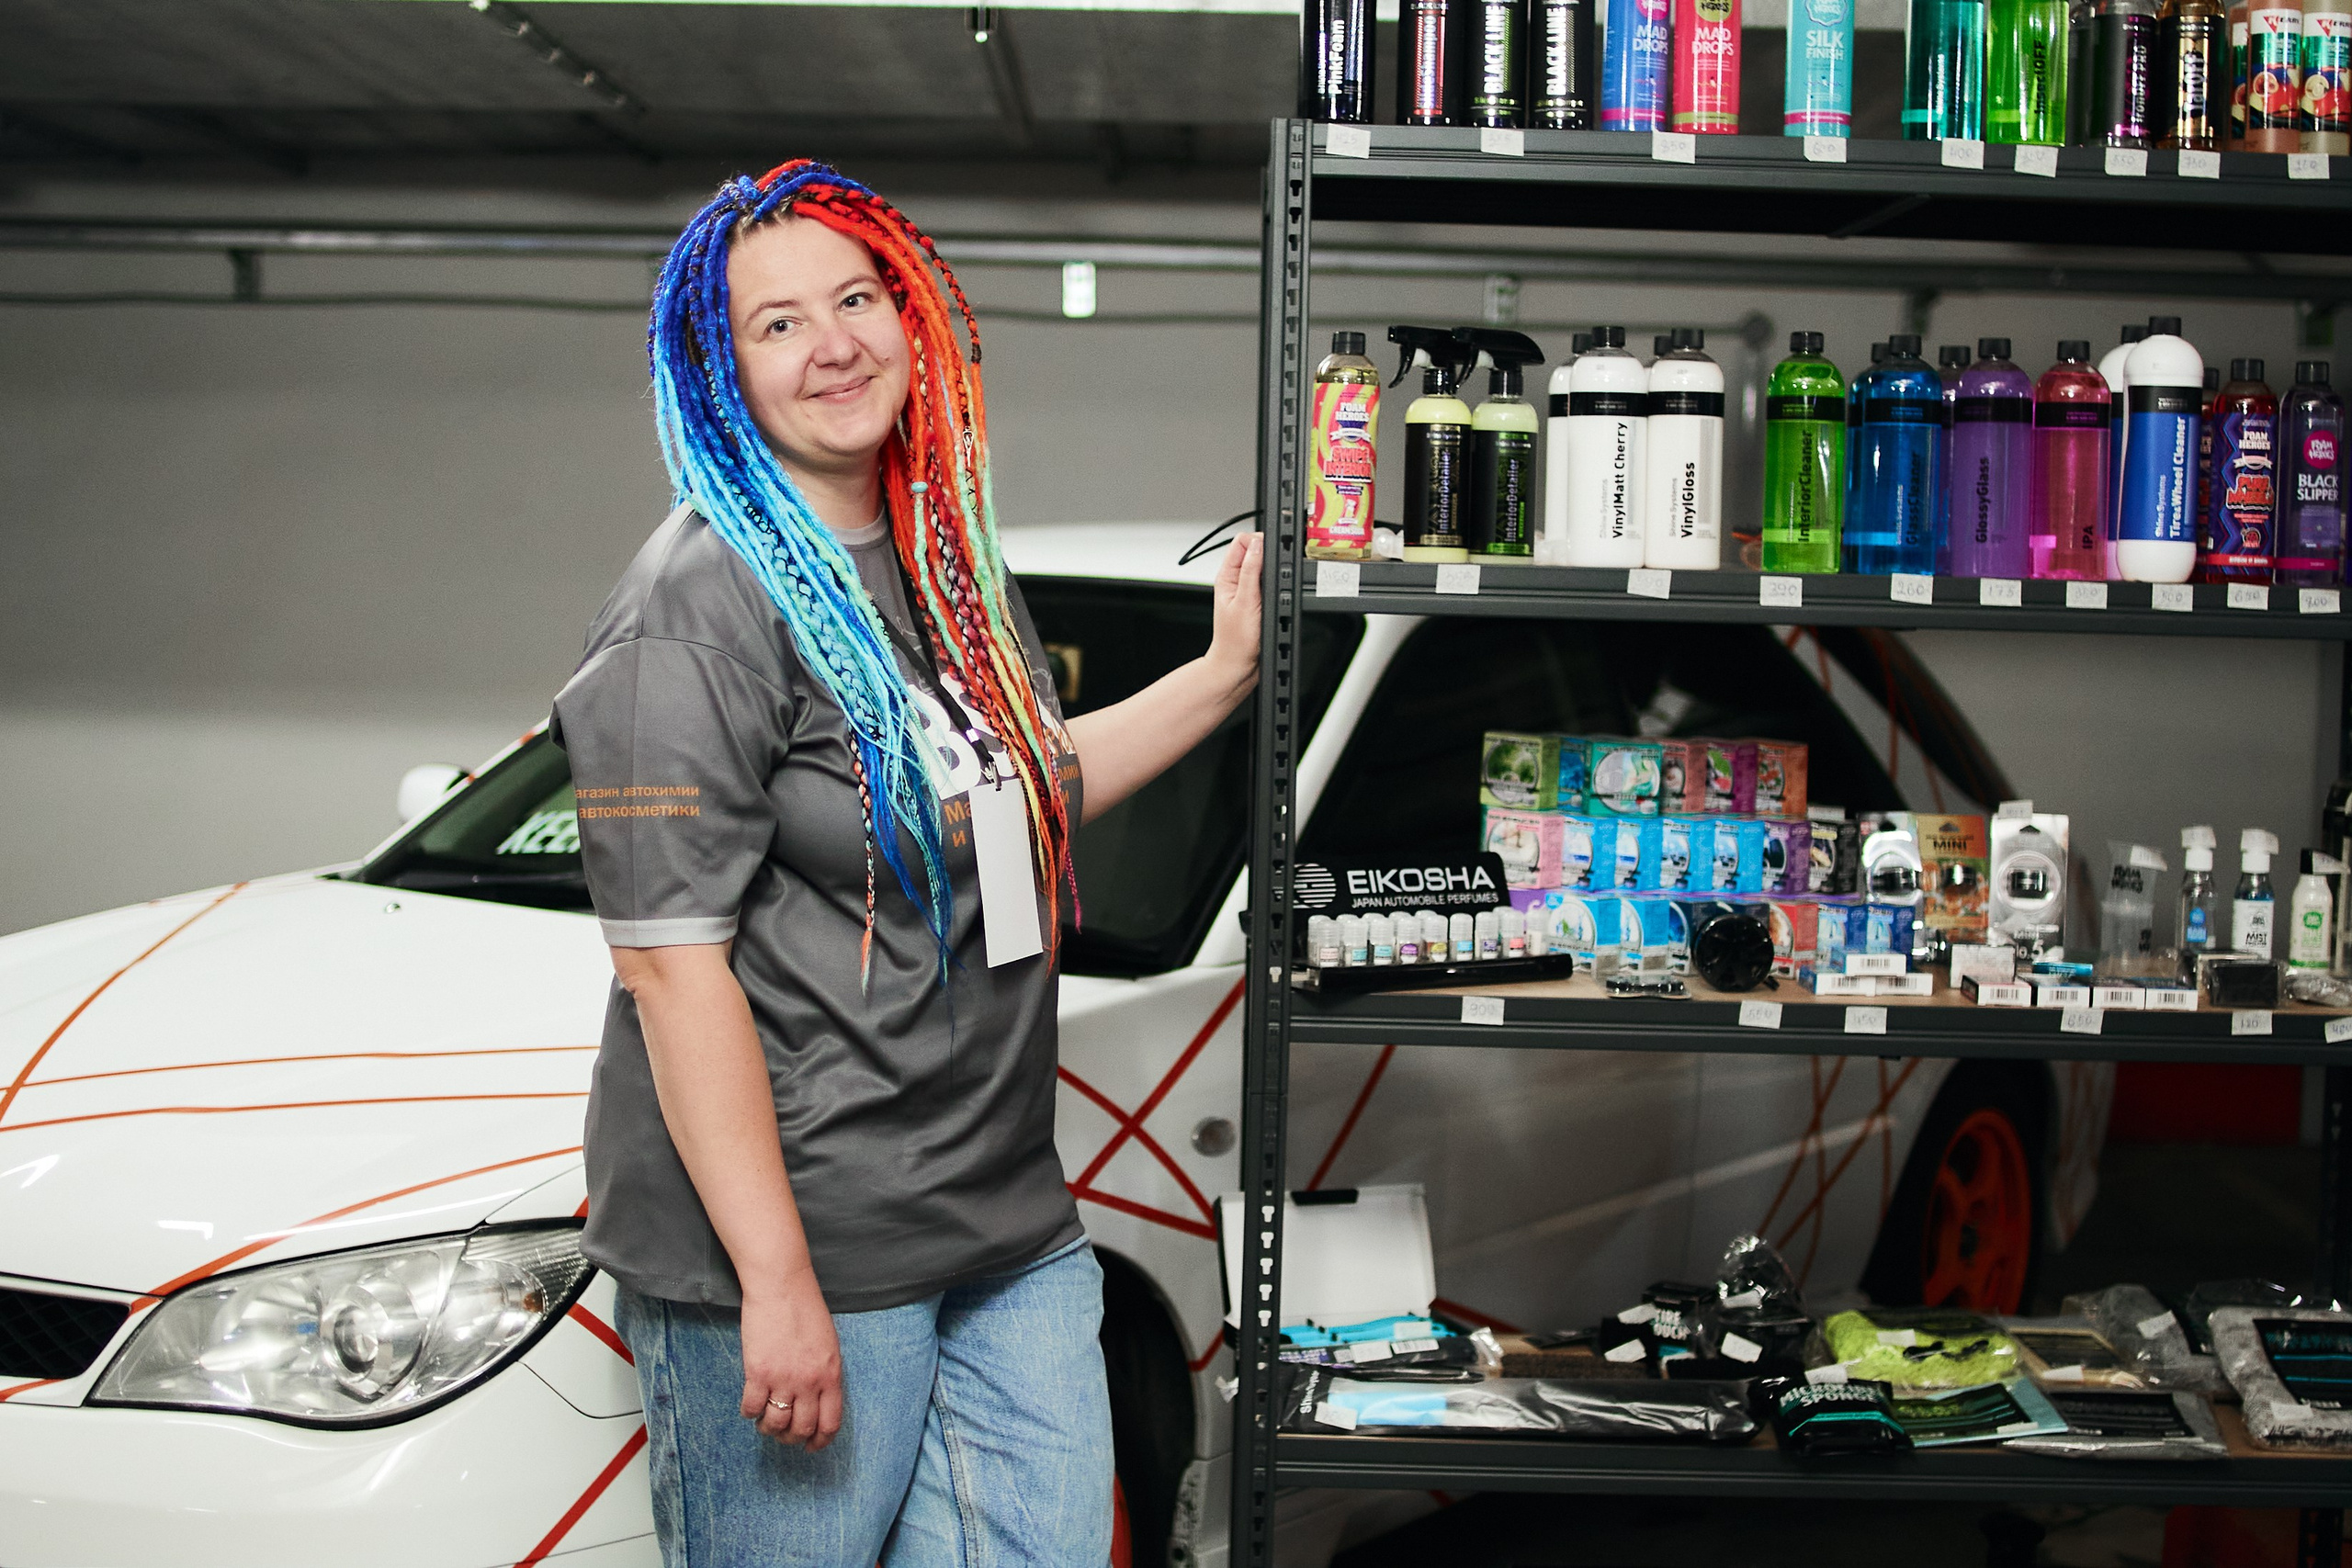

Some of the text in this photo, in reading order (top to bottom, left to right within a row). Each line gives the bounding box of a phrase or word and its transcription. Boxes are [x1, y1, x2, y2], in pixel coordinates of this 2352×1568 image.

[1485, 5, 1506, 40] LINE
[1546, 6, 1566, 42] LINE
[1636, 25, 1668, 40] MAD
[1695, 27, 1732, 41] MAD
[1806, 29, 1844, 49] SILK
[1328, 19, 1345, 95] PinkFoam
[1633, 39, 1668, 55] DROPS
[1692, 40, 1735, 56] DROPS
[1806, 47, 1844, 61] FINISH
[1484, 43, 1505, 94] BLACK
[1546, 45, 1566, 96] BLACK
[1335, 411, 1371, 422] HEROES
[1340, 401, 1367, 412] FOAM
[2173, 416, 2187, 466] Cleaner
[1612, 422, 1628, 539] VinylMatt Cherry
[1797, 428, 1813, 544] InteriorCleaner
[2298, 473, 2338, 489] BLACK
[1437, 450, 1452, 534] InteriorDetailer
[1504, 458, 1519, 542] InteriorDetailer
[1680, 461, 1696, 538] VinylGloss
[1905, 451, 1921, 546] GlassCleaner
[1975, 457, 1991, 544] GlossyGlass
[2297, 488, 2339, 502] SLIPPER
[2082, 525, 2094, 549] IPA
[1769, 581, 1798, 597] 390
[1897, 581, 1925, 597] 260
[1988, 584, 2015, 599] 175
[623, 785, 700, 797] автохимии
[578, 805, 700, 819] автокосметики
[496, 809, 581, 855] KEE
[1933, 840, 1967, 851] MINI
[1347, 865, 1496, 895] EIKOSHA
[1351, 893, 1499, 908] JAPAN AUTOMOBILE PERFUMES
